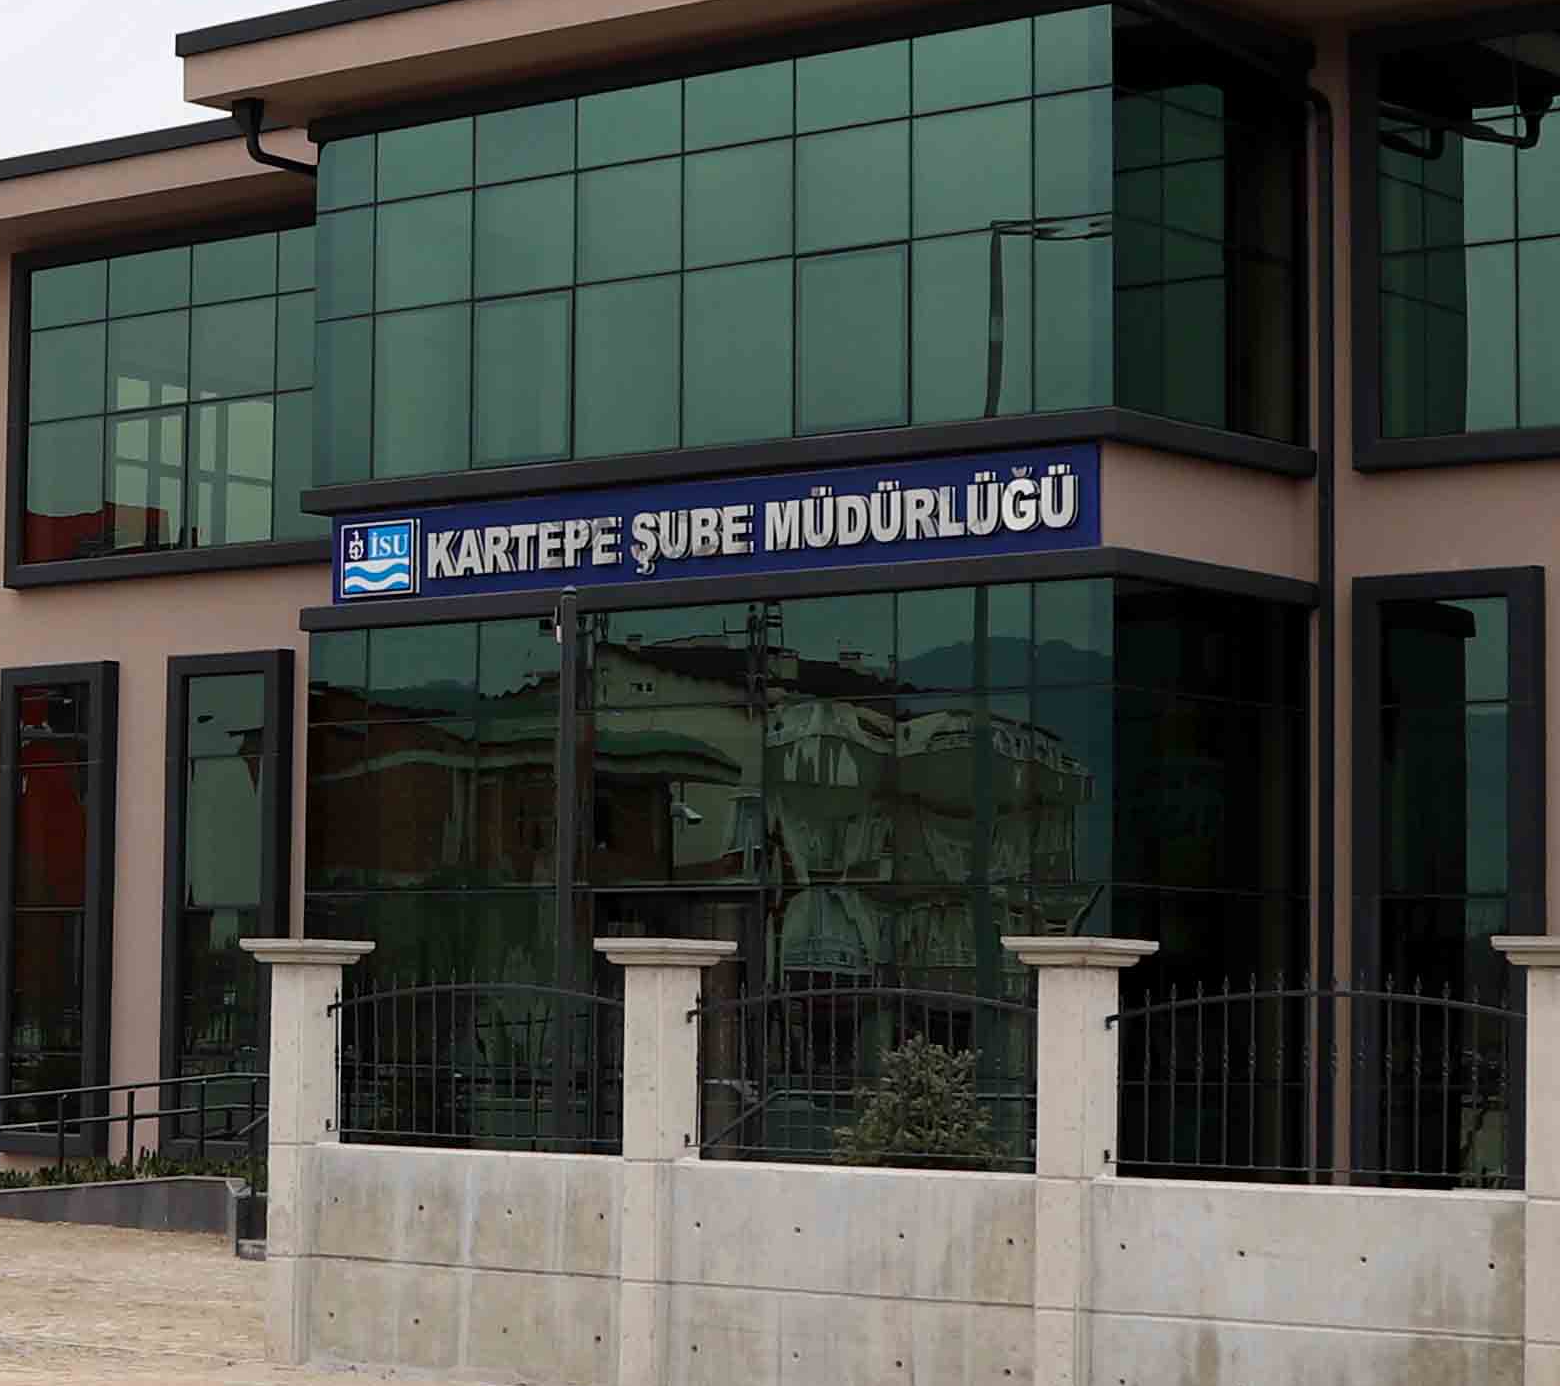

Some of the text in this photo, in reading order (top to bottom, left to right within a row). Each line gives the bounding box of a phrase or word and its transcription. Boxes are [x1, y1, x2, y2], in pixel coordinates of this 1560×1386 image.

[371, 532, 409, 557] İSU
[427, 463, 1079, 579] KARTEPE ŞUBE MÜDÜRLÜĞÜ
